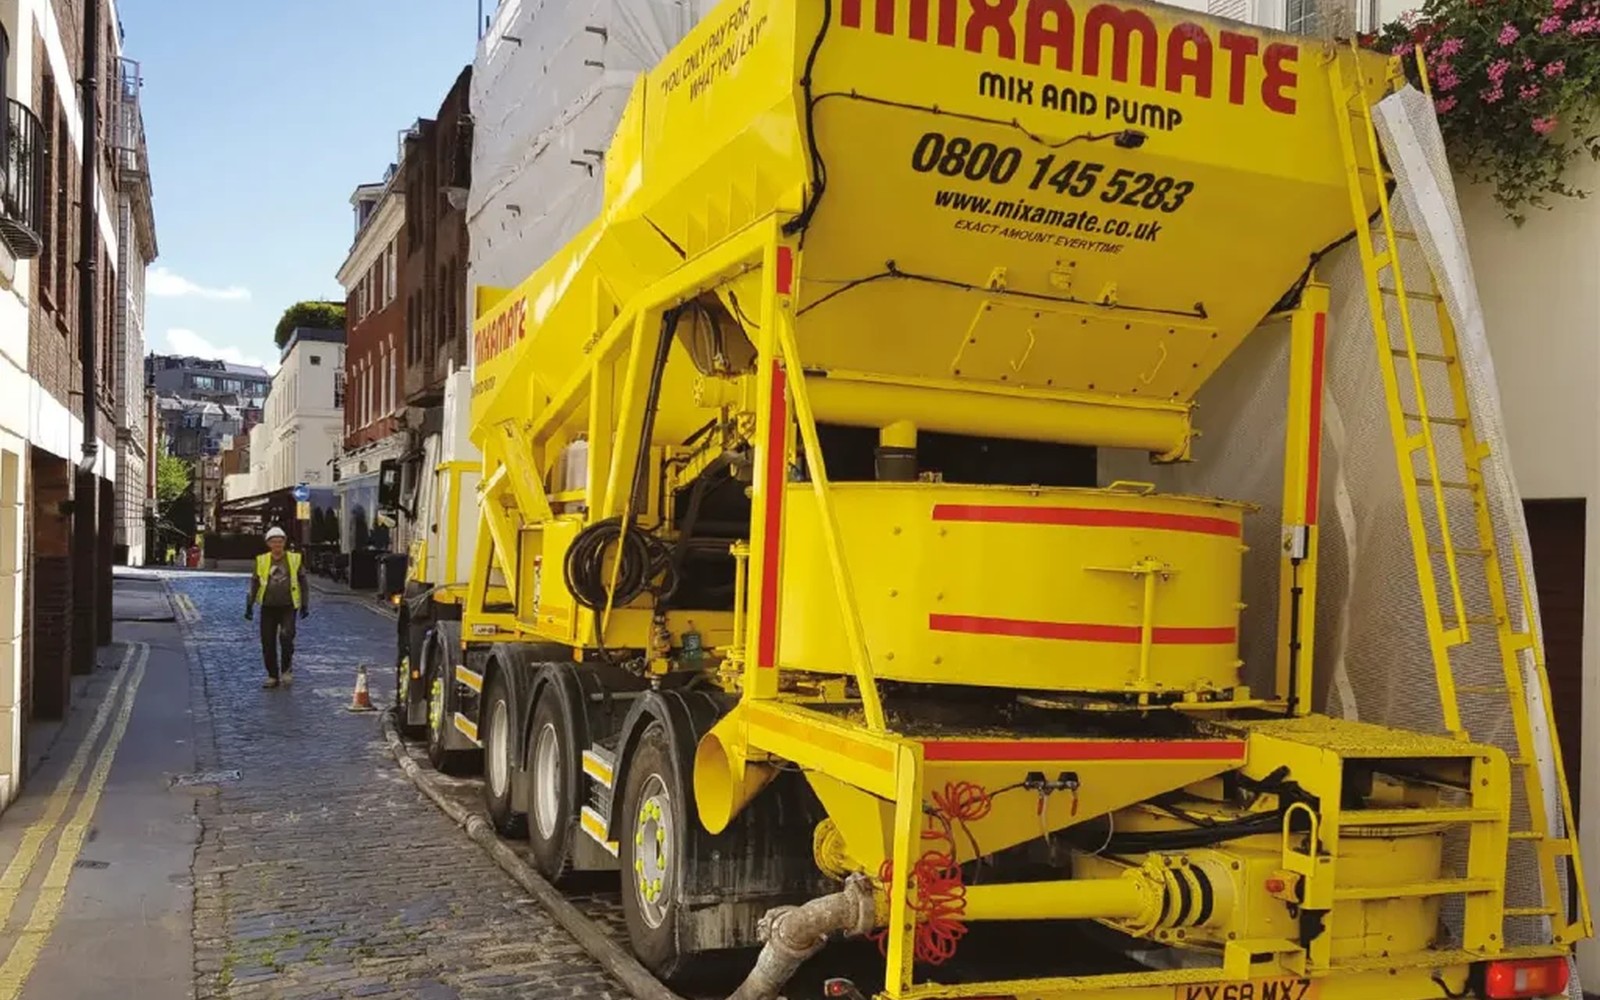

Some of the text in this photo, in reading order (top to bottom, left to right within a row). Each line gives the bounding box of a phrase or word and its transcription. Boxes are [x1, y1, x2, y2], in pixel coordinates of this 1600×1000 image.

[682, 38, 709, 80] ONLY
[707, 21, 728, 57] PAY
[727, 0, 751, 36] FOR
[689, 59, 717, 103] WHAT
[717, 38, 740, 76] YOU
[979, 71, 1183, 131] MIX AND PUMP
[911, 132, 1195, 213] 0800 145 5283
[934, 189, 1162, 242] www.mixamate.co.uk
[954, 219, 1125, 255] EXACT AMOUNT EVERYTIME
